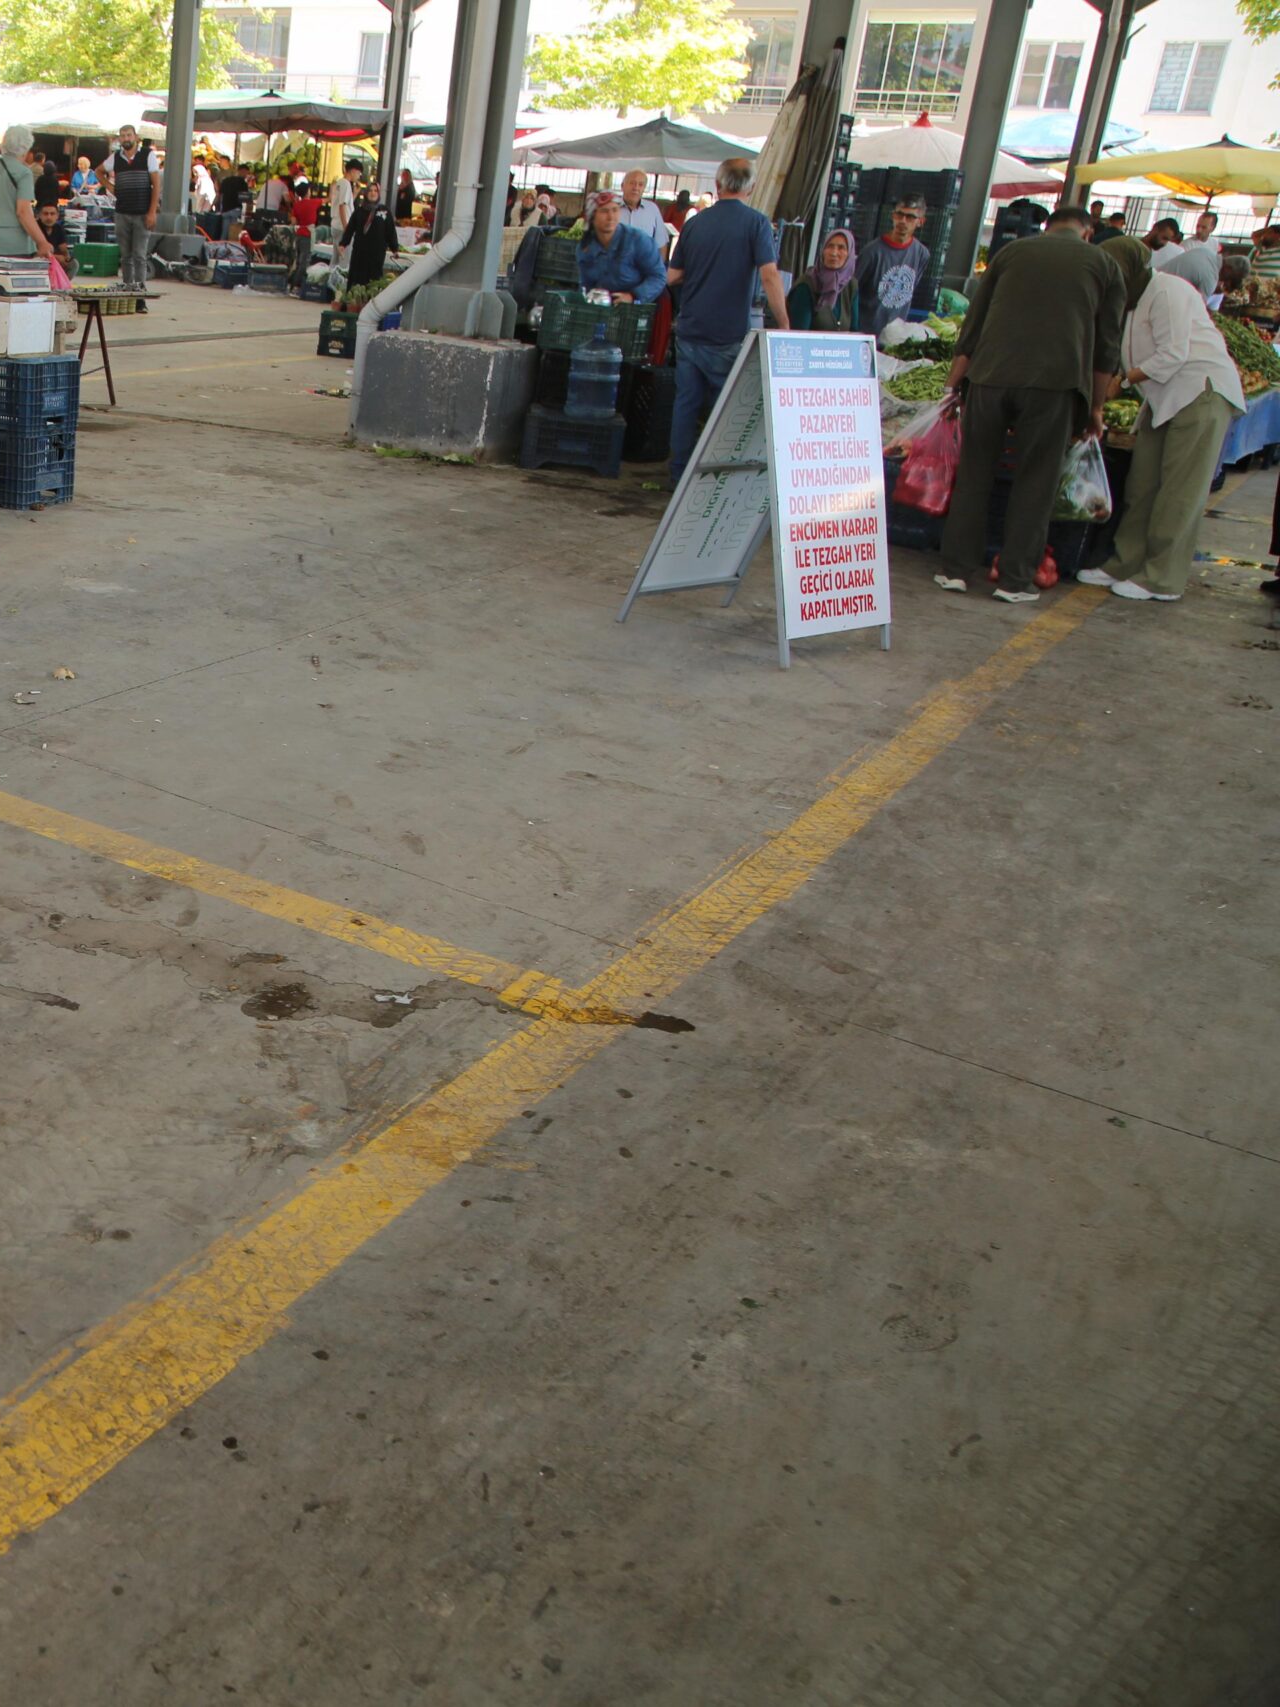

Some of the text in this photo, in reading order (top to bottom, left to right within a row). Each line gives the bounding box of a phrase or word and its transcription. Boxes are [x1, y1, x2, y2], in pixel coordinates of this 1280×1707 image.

[778, 384, 872, 407] BU TEZGAH SAHİBİ
[788, 437, 870, 461] YÖNETMELİĞİNE
[791, 463, 871, 488] UYMADIĞINDAN
[789, 489, 876, 515] DOLAYI BELEDİYE
[790, 516, 878, 542] ENCÜMEN KARARI
[794, 539, 876, 569] İLE TEZGAH YERİ
[800, 568, 875, 596] GEÇİCİ OLARAK
[800, 594, 877, 622] KAPATILMIŞTIR.
